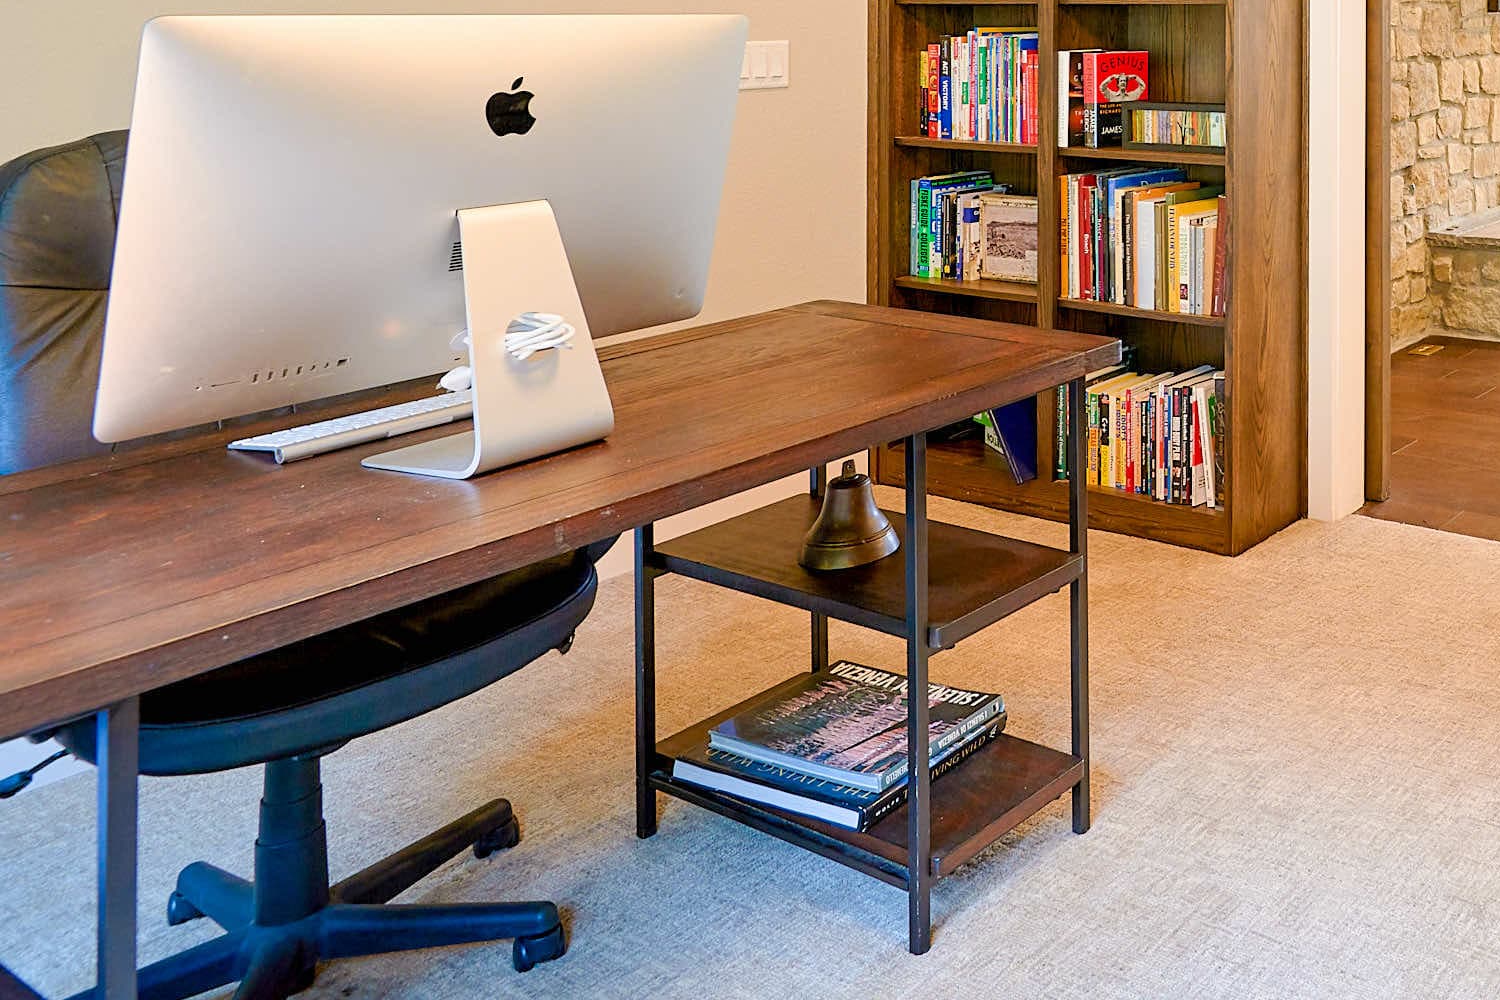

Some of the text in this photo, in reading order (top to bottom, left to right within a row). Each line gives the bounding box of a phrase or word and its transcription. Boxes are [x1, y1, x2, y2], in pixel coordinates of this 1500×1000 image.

[1100, 57, 1144, 72] GENIUS
[1102, 126, 1123, 135] JAMES
[920, 189, 928, 264] FISKE GUIDE COLLEGES
[830, 662, 898, 689] VENEZIA
[938, 730, 961, 748] VENEZIA
[931, 735, 986, 779] IVING WILD
[757, 764, 830, 788] LIVING
[832, 784, 874, 800] THE
